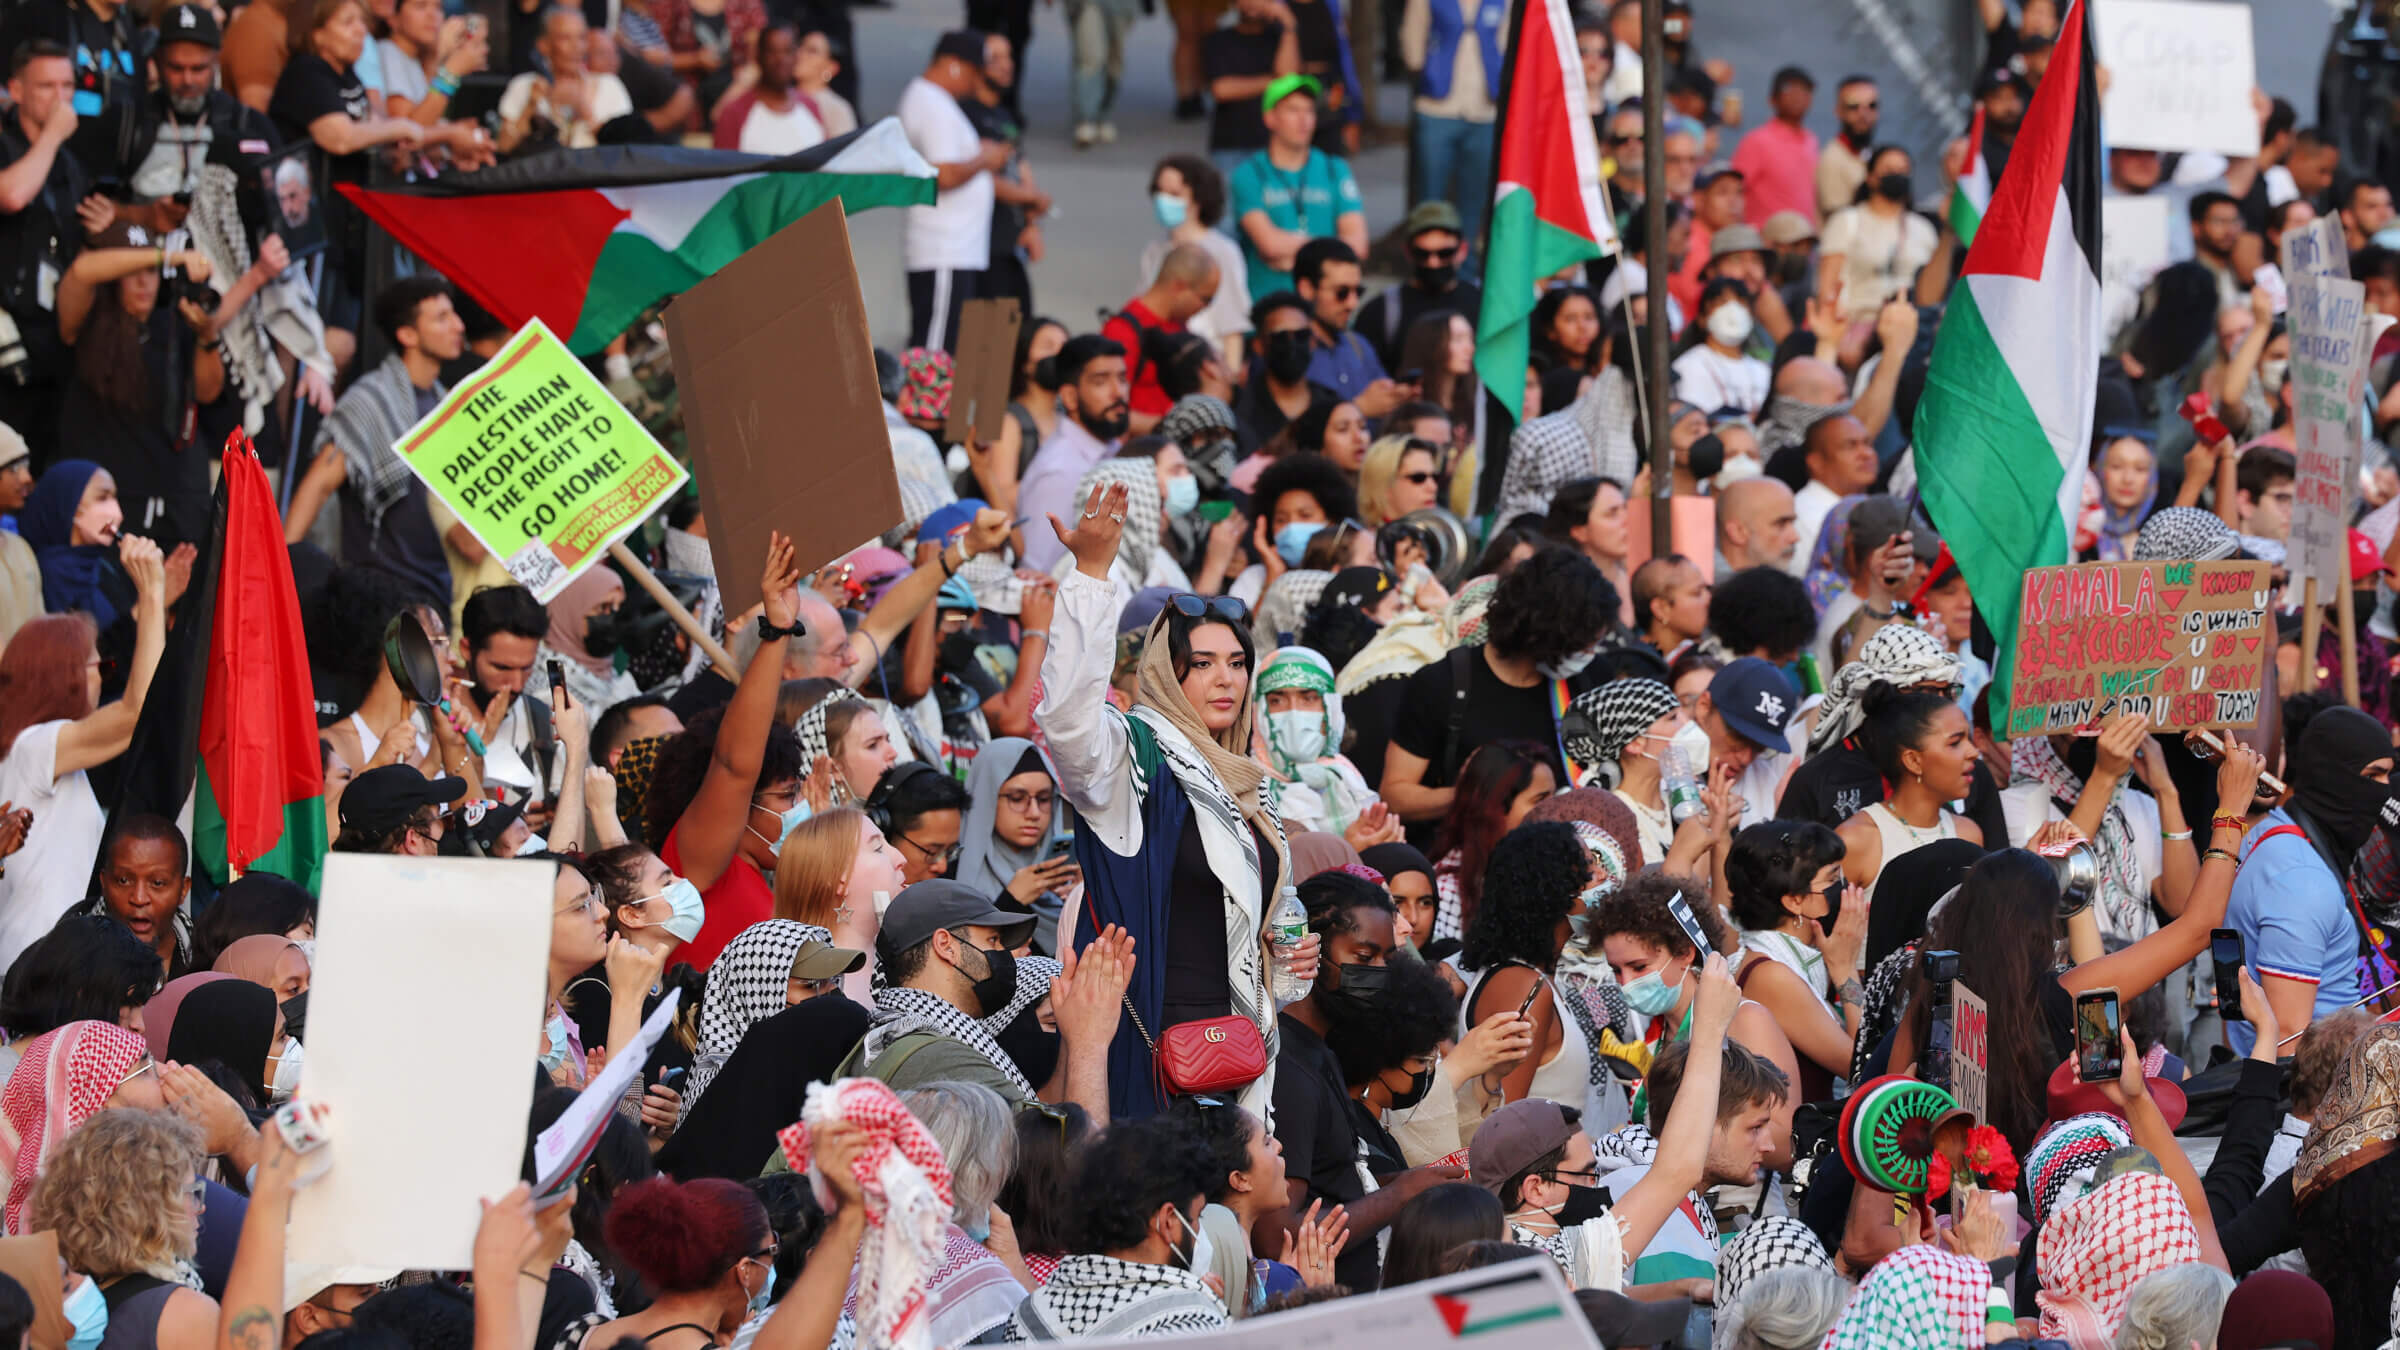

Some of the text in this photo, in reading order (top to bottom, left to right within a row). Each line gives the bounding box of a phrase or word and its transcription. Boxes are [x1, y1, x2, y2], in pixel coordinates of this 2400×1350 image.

[442, 374, 572, 485] PALESTINIAN
[462, 385, 507, 423] THE
[460, 394, 595, 509] PEOPLE HAVE
[484, 415, 612, 523] THE RIGHT TO
[521, 448, 627, 538] GO HOME!
[557, 459, 659, 547] WORKERS WORLD PARTY
[572, 470, 671, 553] WORKERS.ORG
[2024, 566, 2156, 625] KAMALA
[2165, 562, 2269, 610] WE KNOW U
[2181, 608, 2266, 634] IS WHAT
[2191, 634, 2237, 659] U DO
[2011, 704, 2048, 734] HOW
[2120, 694, 2154, 721] DID
[2156, 695, 2170, 727] U
[2170, 692, 2217, 727] SEND
[2215, 687, 2261, 724] TODAY
[2014, 663, 2256, 709] KAMALA WHAT DO U SAY
[1954, 998, 1988, 1072] ARMS
